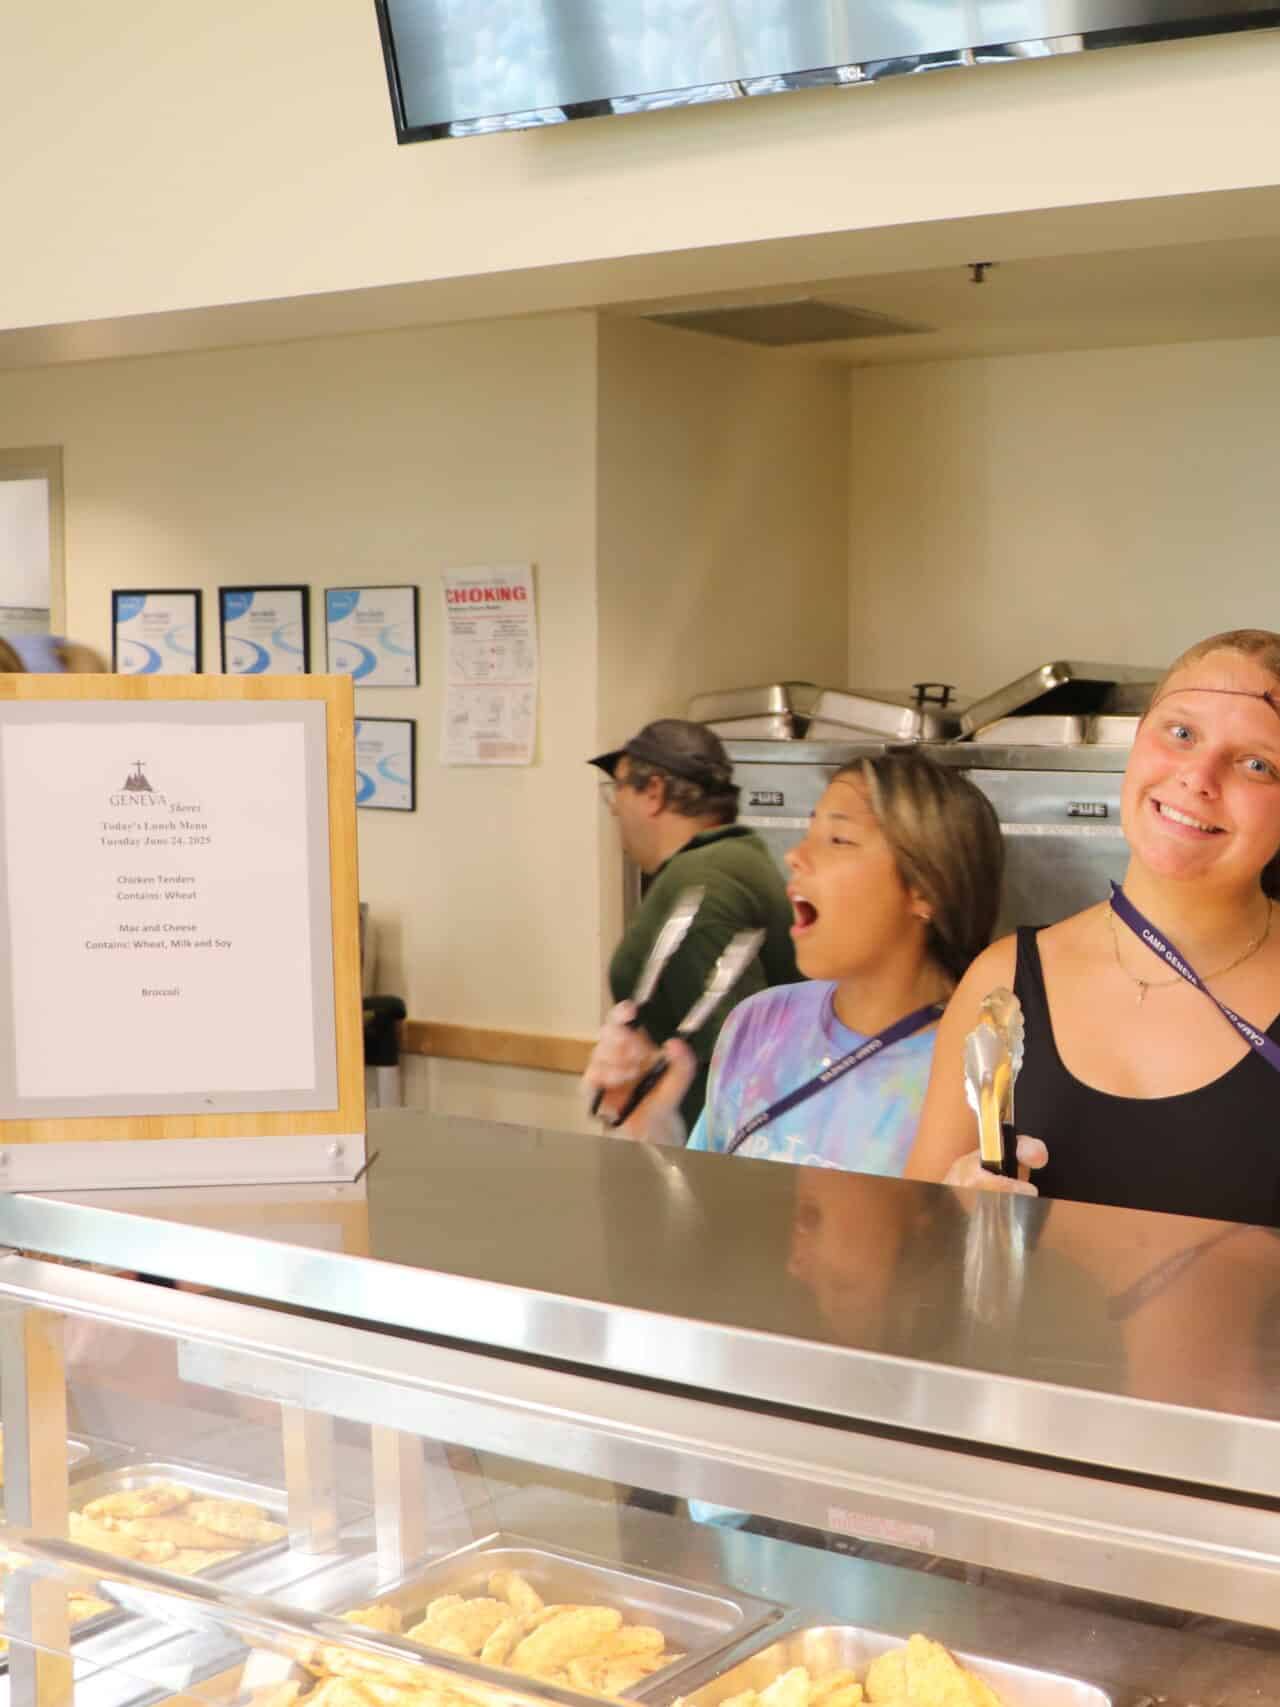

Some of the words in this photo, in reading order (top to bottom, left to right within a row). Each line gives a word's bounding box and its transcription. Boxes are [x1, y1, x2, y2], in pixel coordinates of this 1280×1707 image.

[109, 794, 167, 807] GENEVA
[103, 821, 142, 832] Today's
[144, 821, 176, 831] Lunch
[179, 820, 208, 831] Menu
[101, 837, 140, 847] Tuesday
[144, 837, 168, 846] June
[187, 835, 212, 846] 2025
[117, 875, 154, 884] Chicken
[157, 874, 195, 884] Tenders
[117, 892, 162, 901] Contains:
[165, 890, 197, 900] Wheat
[119, 924, 139, 933] Mac
[142, 923, 160, 932] and
[163, 923, 198, 932] Cheese
[85, 940, 130, 950] Contains:
[133, 939, 168, 950] Wheat,
[171, 938, 191, 948] Milk
[194, 938, 212, 948] and
[215, 938, 232, 949] Soy
[1143, 929, 1166, 952] CAMP
[1166, 951, 1198, 985] GENEVA
[141, 987, 180, 997] Broccoli
[1237, 1022, 1264, 1046] CAMP
